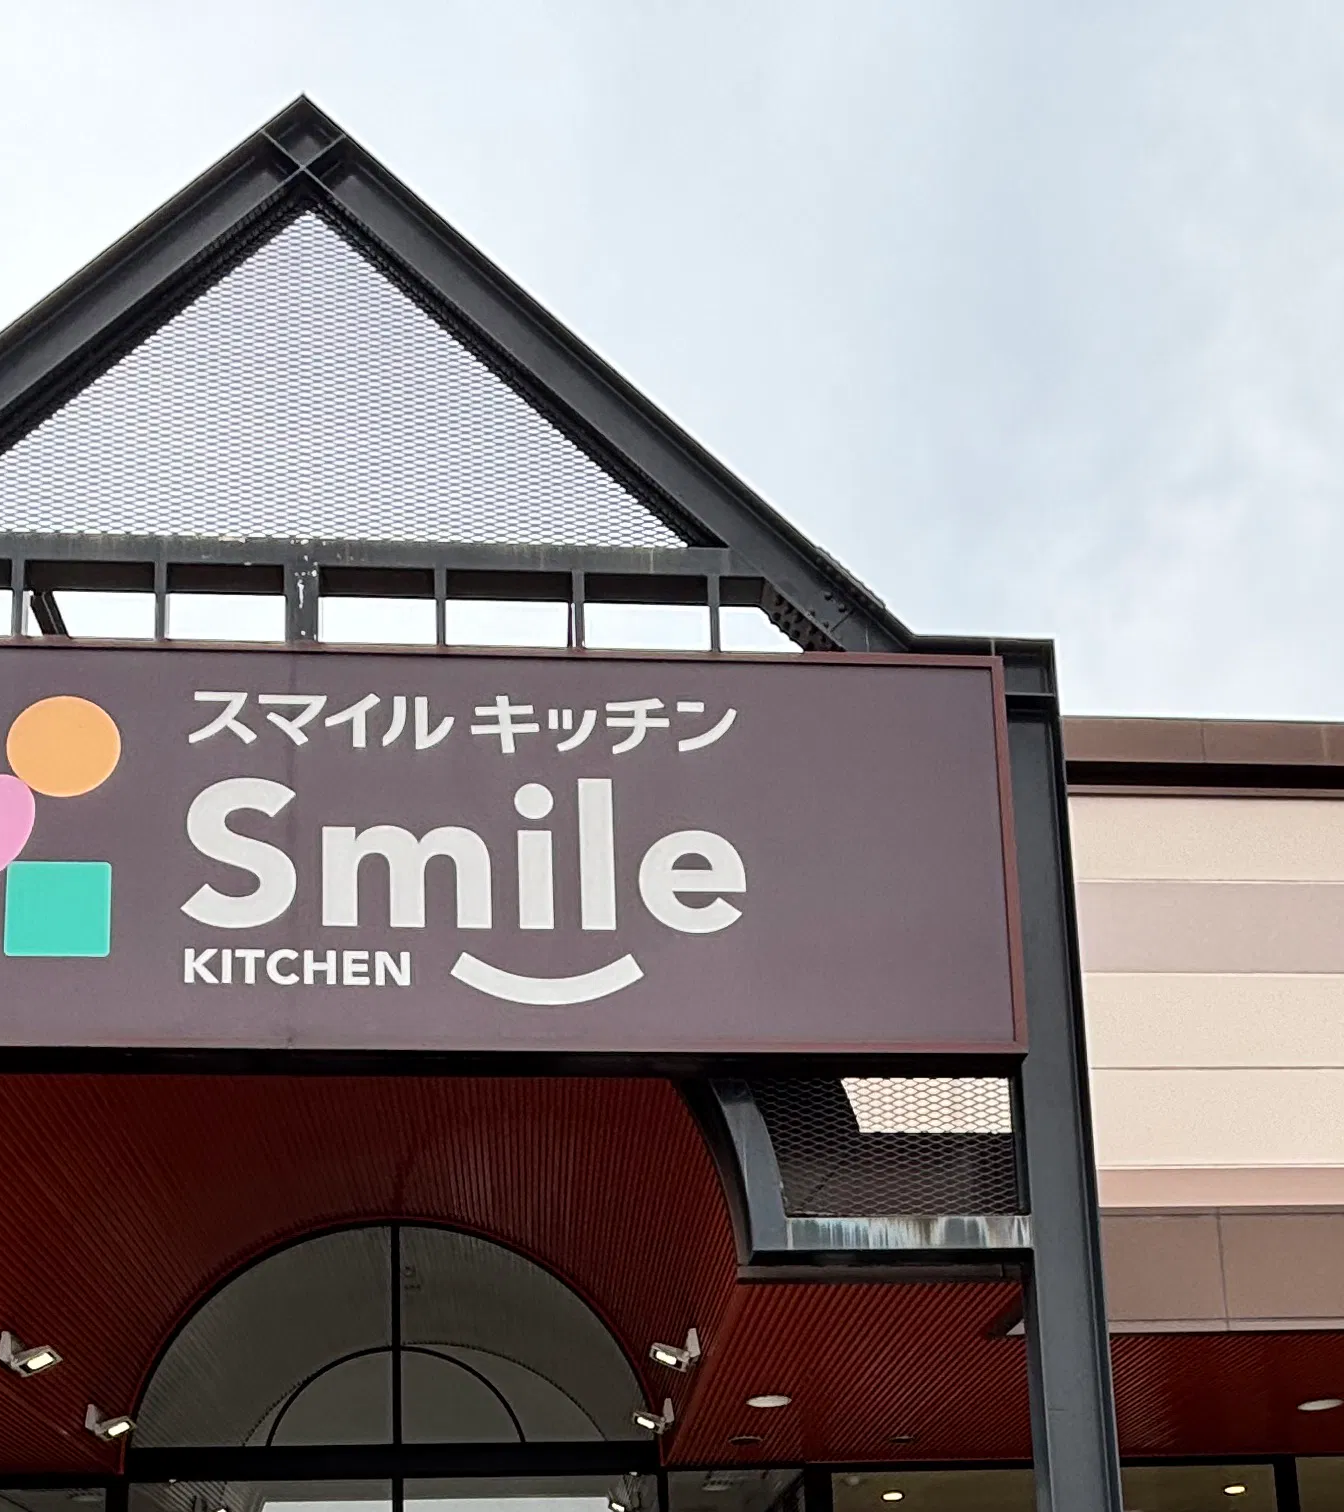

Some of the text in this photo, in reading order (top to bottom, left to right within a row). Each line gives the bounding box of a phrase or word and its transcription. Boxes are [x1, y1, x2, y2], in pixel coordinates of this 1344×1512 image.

[188, 690, 737, 755] スマイル キッチン
[179, 777, 747, 934] Smile
[183, 948, 411, 986] KITCHEN
